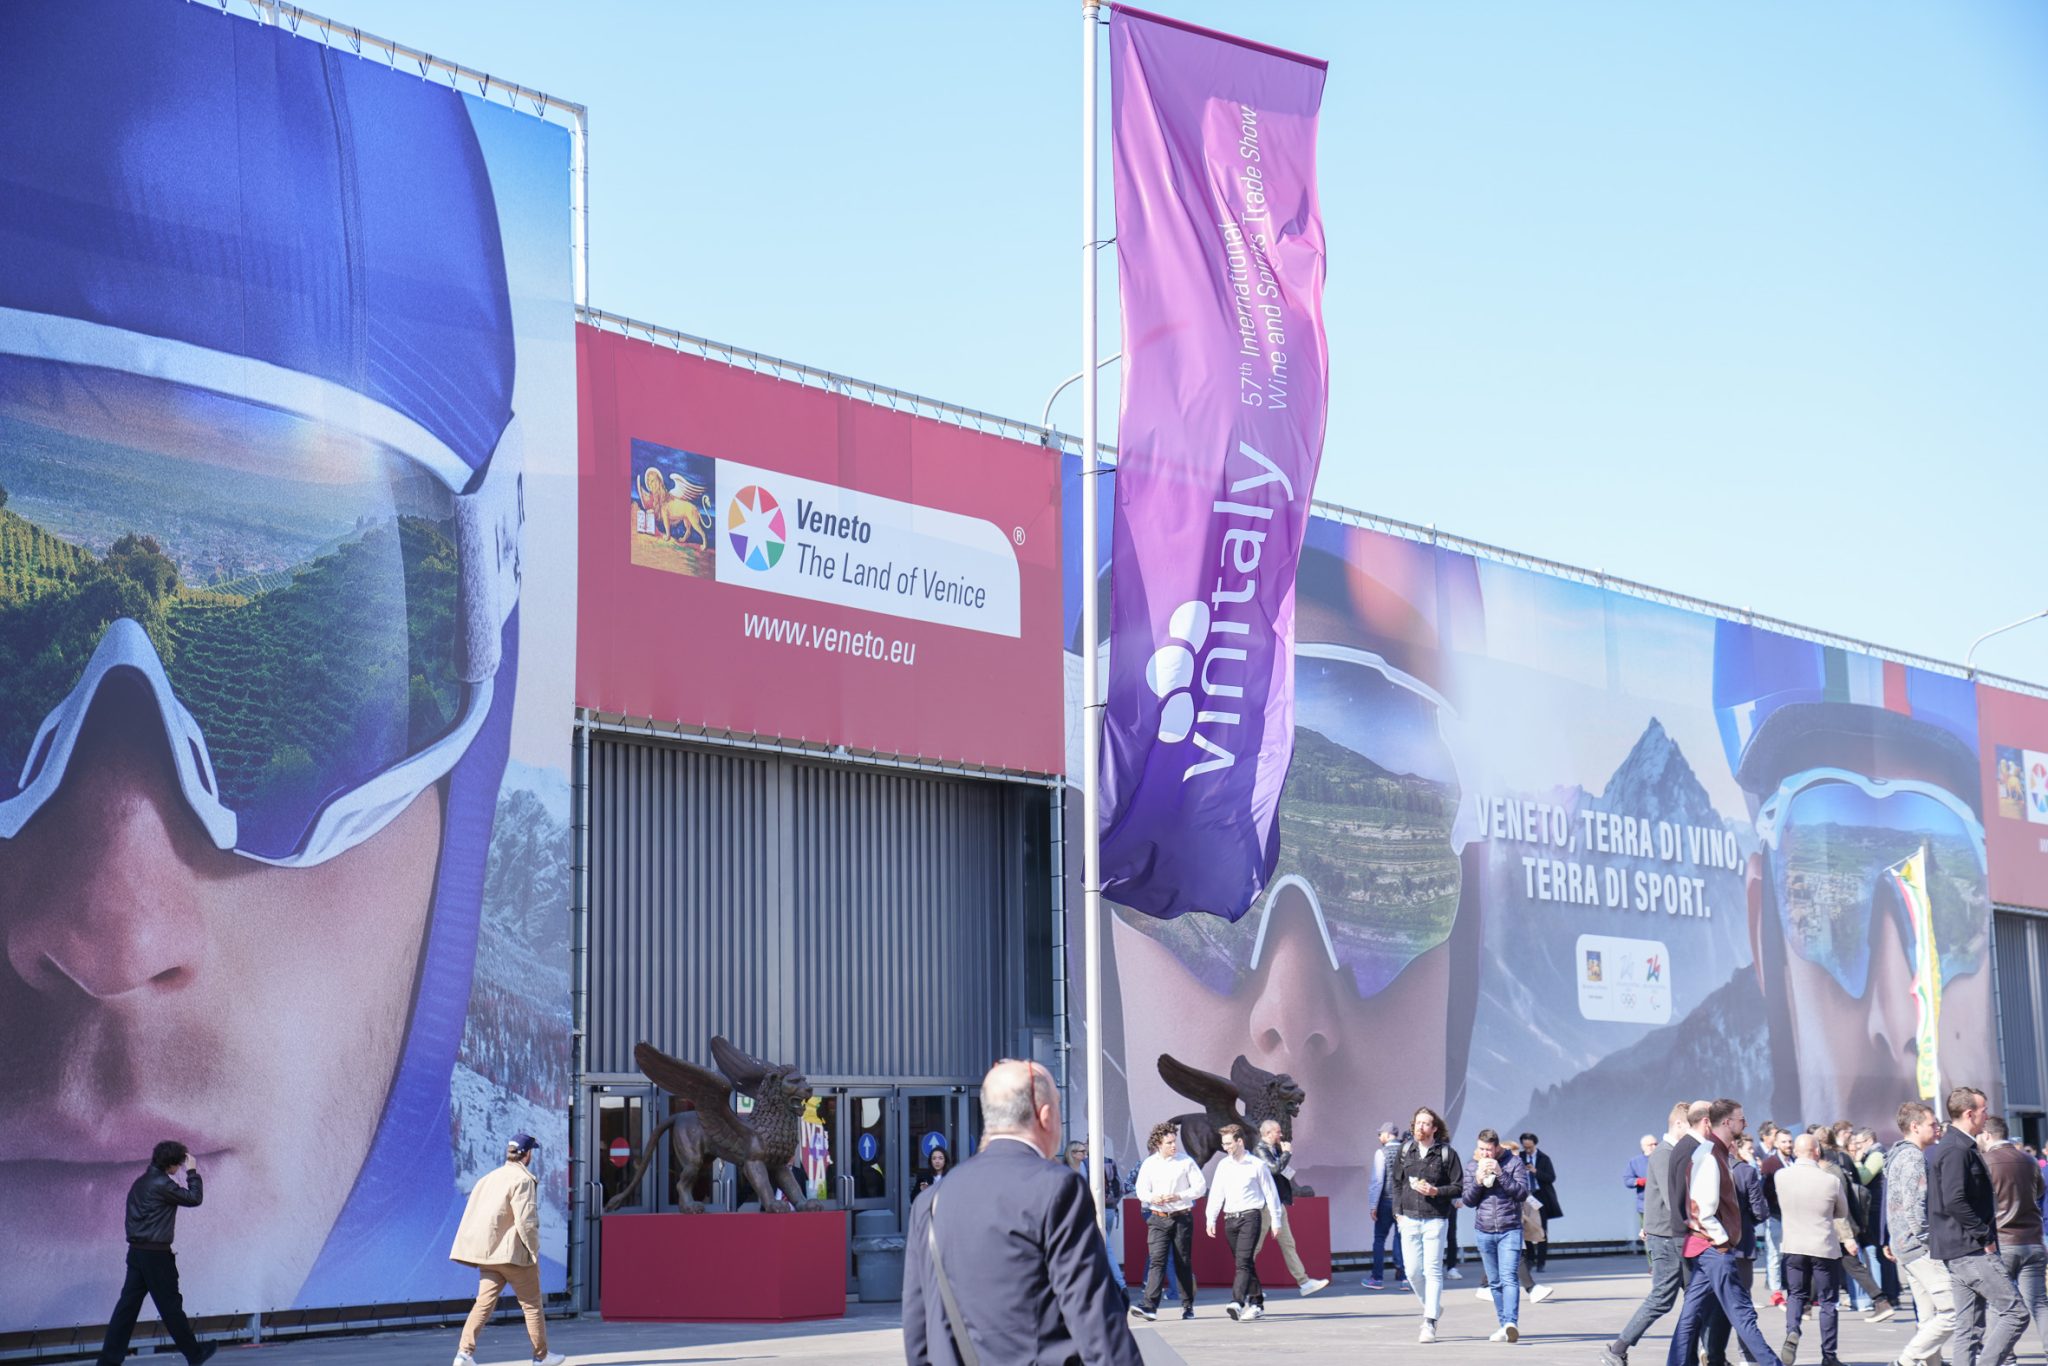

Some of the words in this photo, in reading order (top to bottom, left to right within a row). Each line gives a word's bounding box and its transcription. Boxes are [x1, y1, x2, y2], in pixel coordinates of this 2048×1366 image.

[1240, 105, 1260, 163] Show
[1241, 167, 1267, 223] Trade
[1218, 220, 1258, 357] International
[1253, 232, 1281, 298] Spirits
[1257, 303, 1287, 347] and
[1241, 363, 1262, 408] 57th
[1268, 351, 1287, 410] Wine
[797, 498, 871, 544] Veneto
[797, 542, 835, 579] The
[842, 552, 890, 592] Land
[897, 566, 917, 595] of
[923, 568, 986, 609] Venice
[744, 612, 916, 666] www.veneto.eu
[1182, 440, 1294, 782] vinitaly
[1474, 794, 1576, 853] VENETO,
[1581, 809, 1653, 859] TERRA
[1660, 821, 1683, 863] DI
[1687, 825, 1744, 876] VINO,
[1522, 856, 1599, 906] TERRA
[1605, 866, 1628, 909] DI
[1634, 870, 1711, 918] SPORT.
